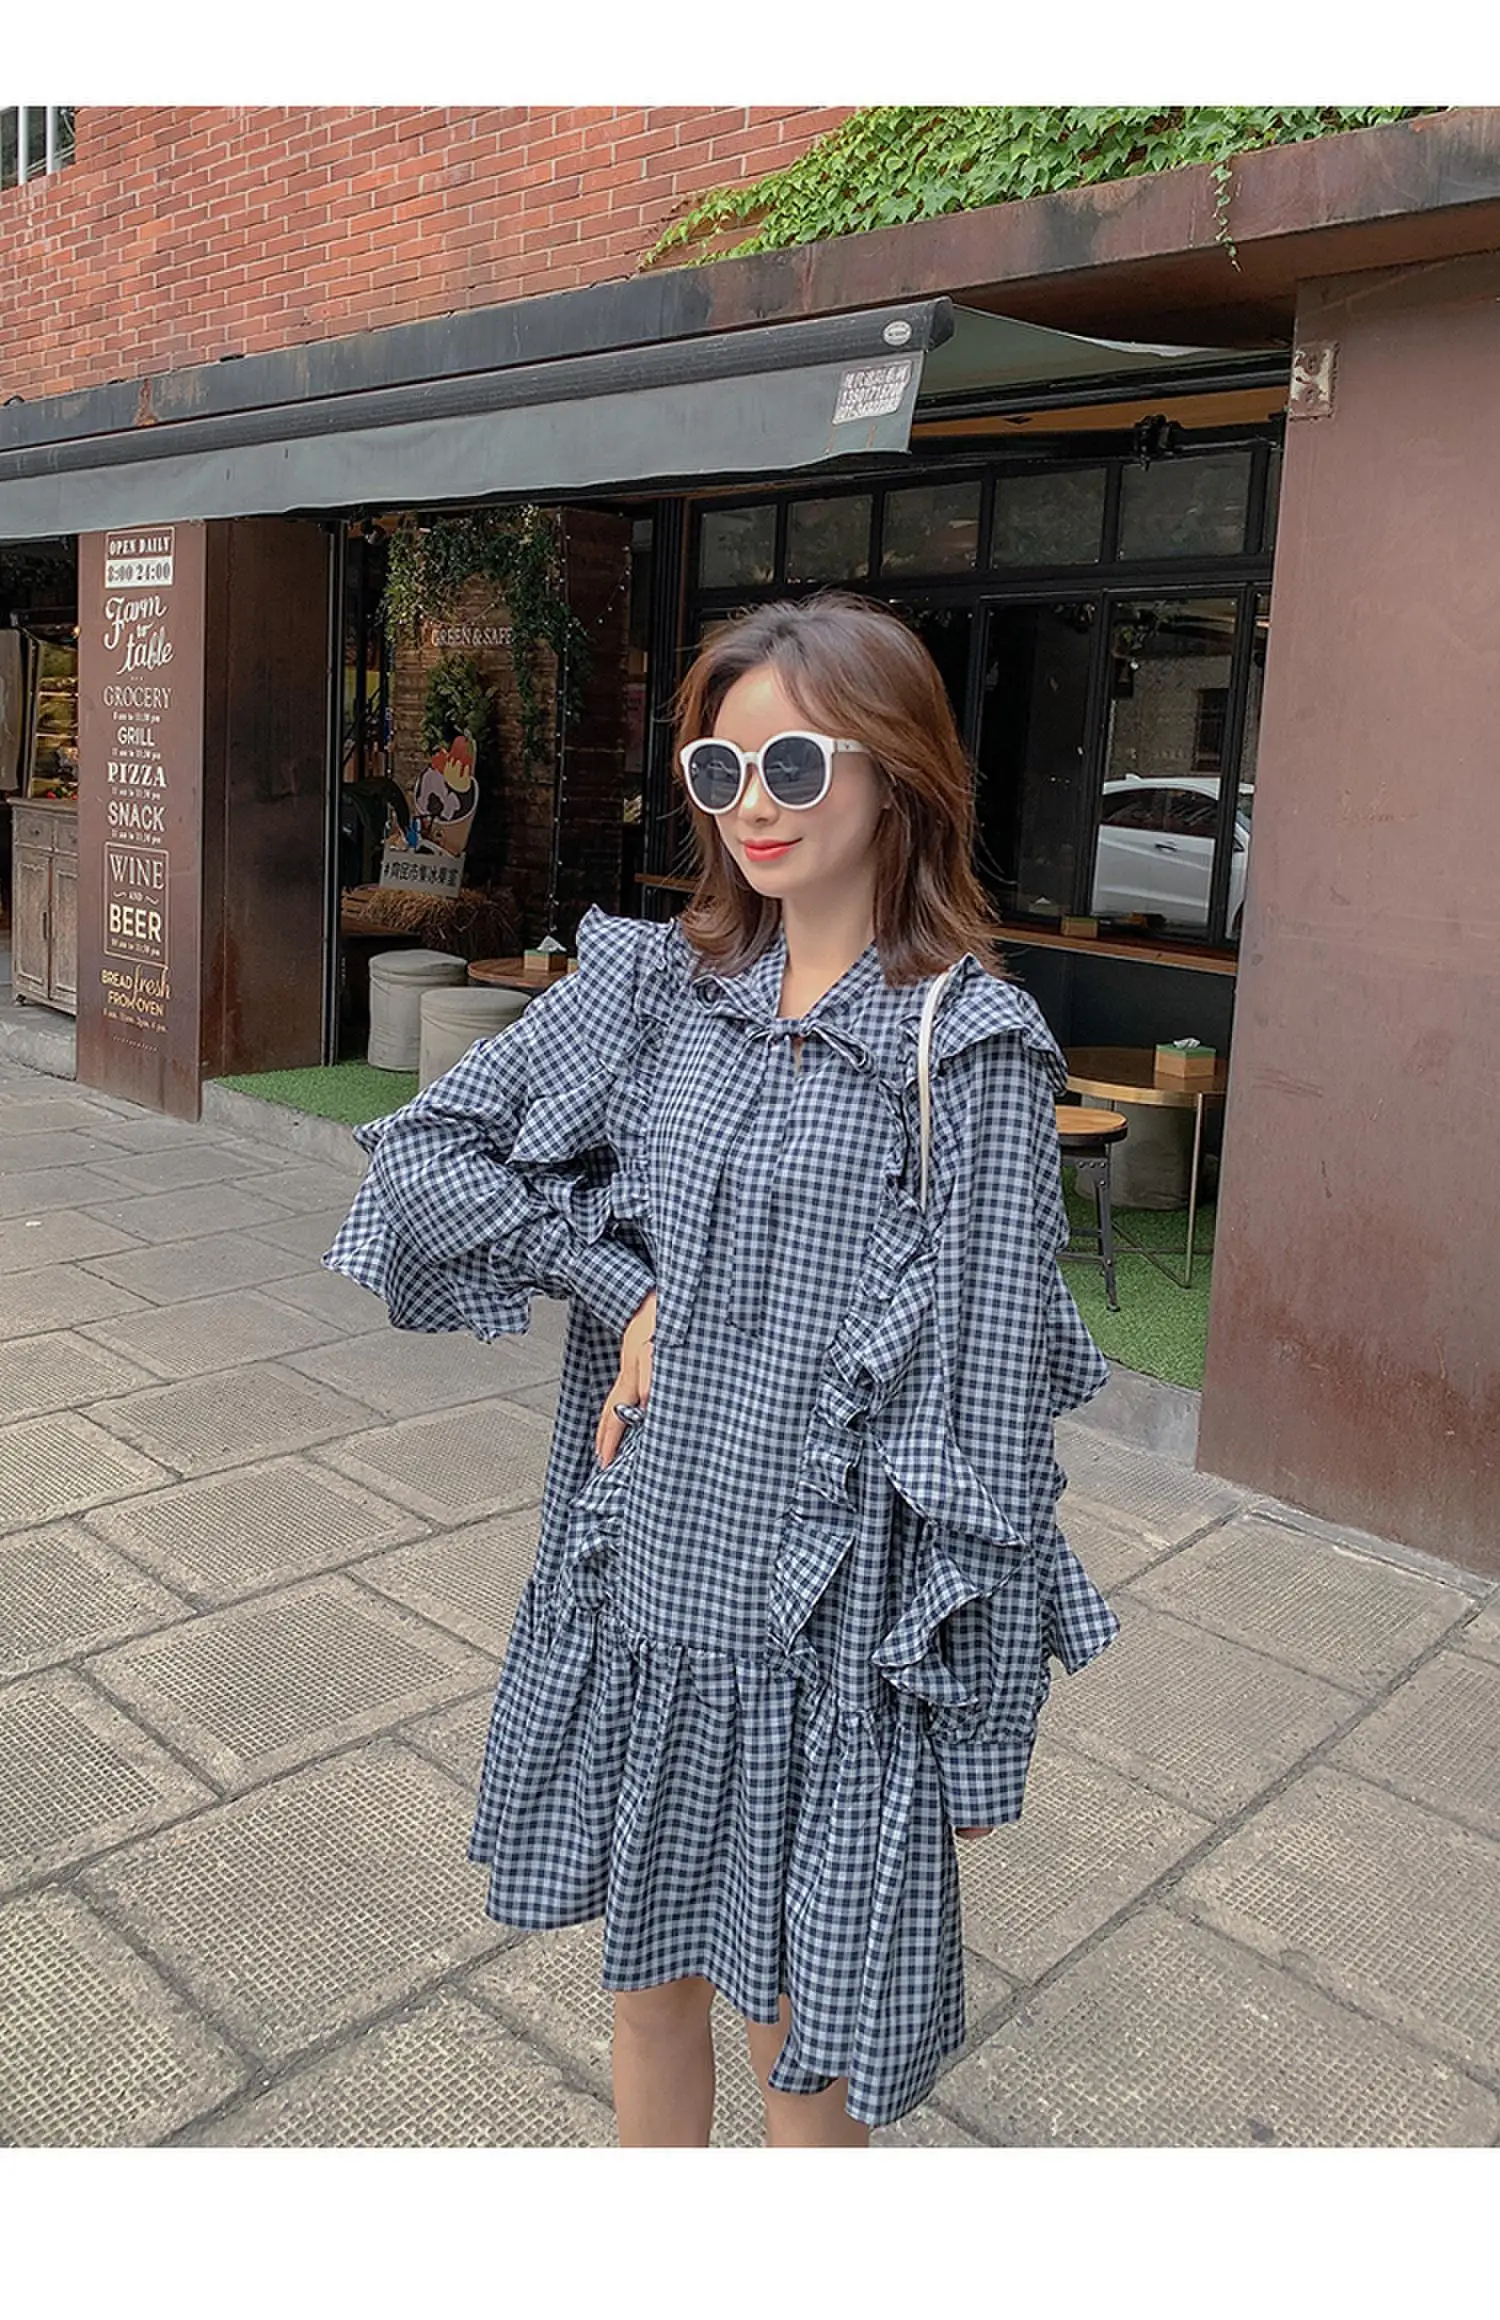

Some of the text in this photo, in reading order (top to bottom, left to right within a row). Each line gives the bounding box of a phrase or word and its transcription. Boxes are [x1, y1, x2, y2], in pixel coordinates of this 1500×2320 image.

[109, 536, 171, 556] OPEN DAILY
[136, 561, 171, 581] 24:00
[104, 596, 167, 649] Farm
[116, 626, 173, 674] table
[103, 685, 171, 708] GROCERY
[117, 726, 155, 747] GRILL
[107, 761, 167, 788] PIZZA
[107, 800, 165, 832] SNACK
[109, 853, 164, 890] WINE
[109, 903, 161, 943] BEER
[101, 963, 170, 1003] BREAD fresh
[108, 990, 165, 1017] FROM OVEN
